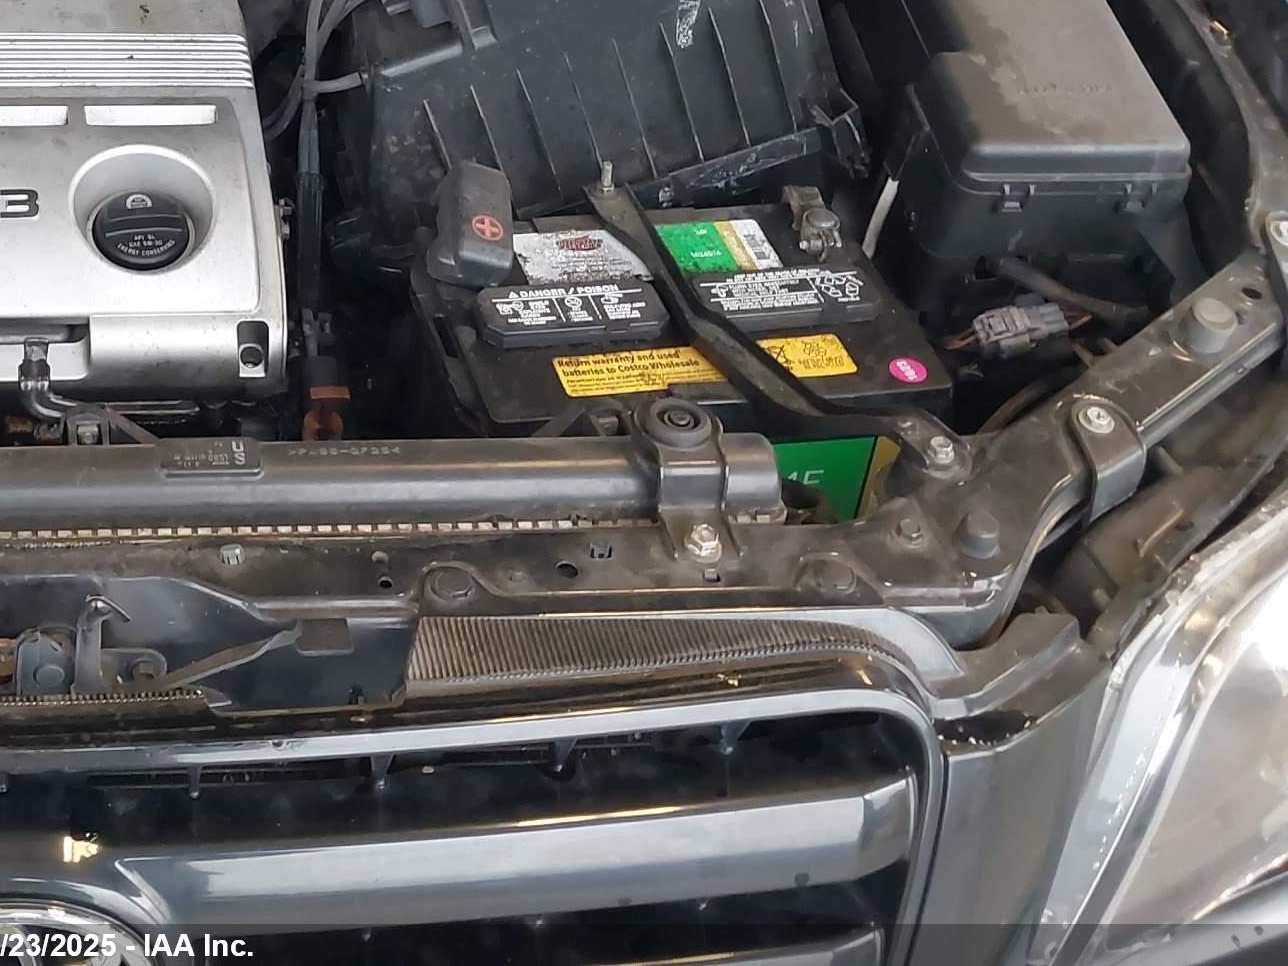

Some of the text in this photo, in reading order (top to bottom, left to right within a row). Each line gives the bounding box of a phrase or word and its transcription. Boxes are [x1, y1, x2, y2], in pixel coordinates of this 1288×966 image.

[117, 239, 175, 256] ENERGY CONSERVING
[520, 288, 566, 298] DANGER
[577, 284, 619, 294] POISON
[558, 350, 680, 368] Return warranty and used
[562, 358, 699, 377] batteries to Costco Wholesale
